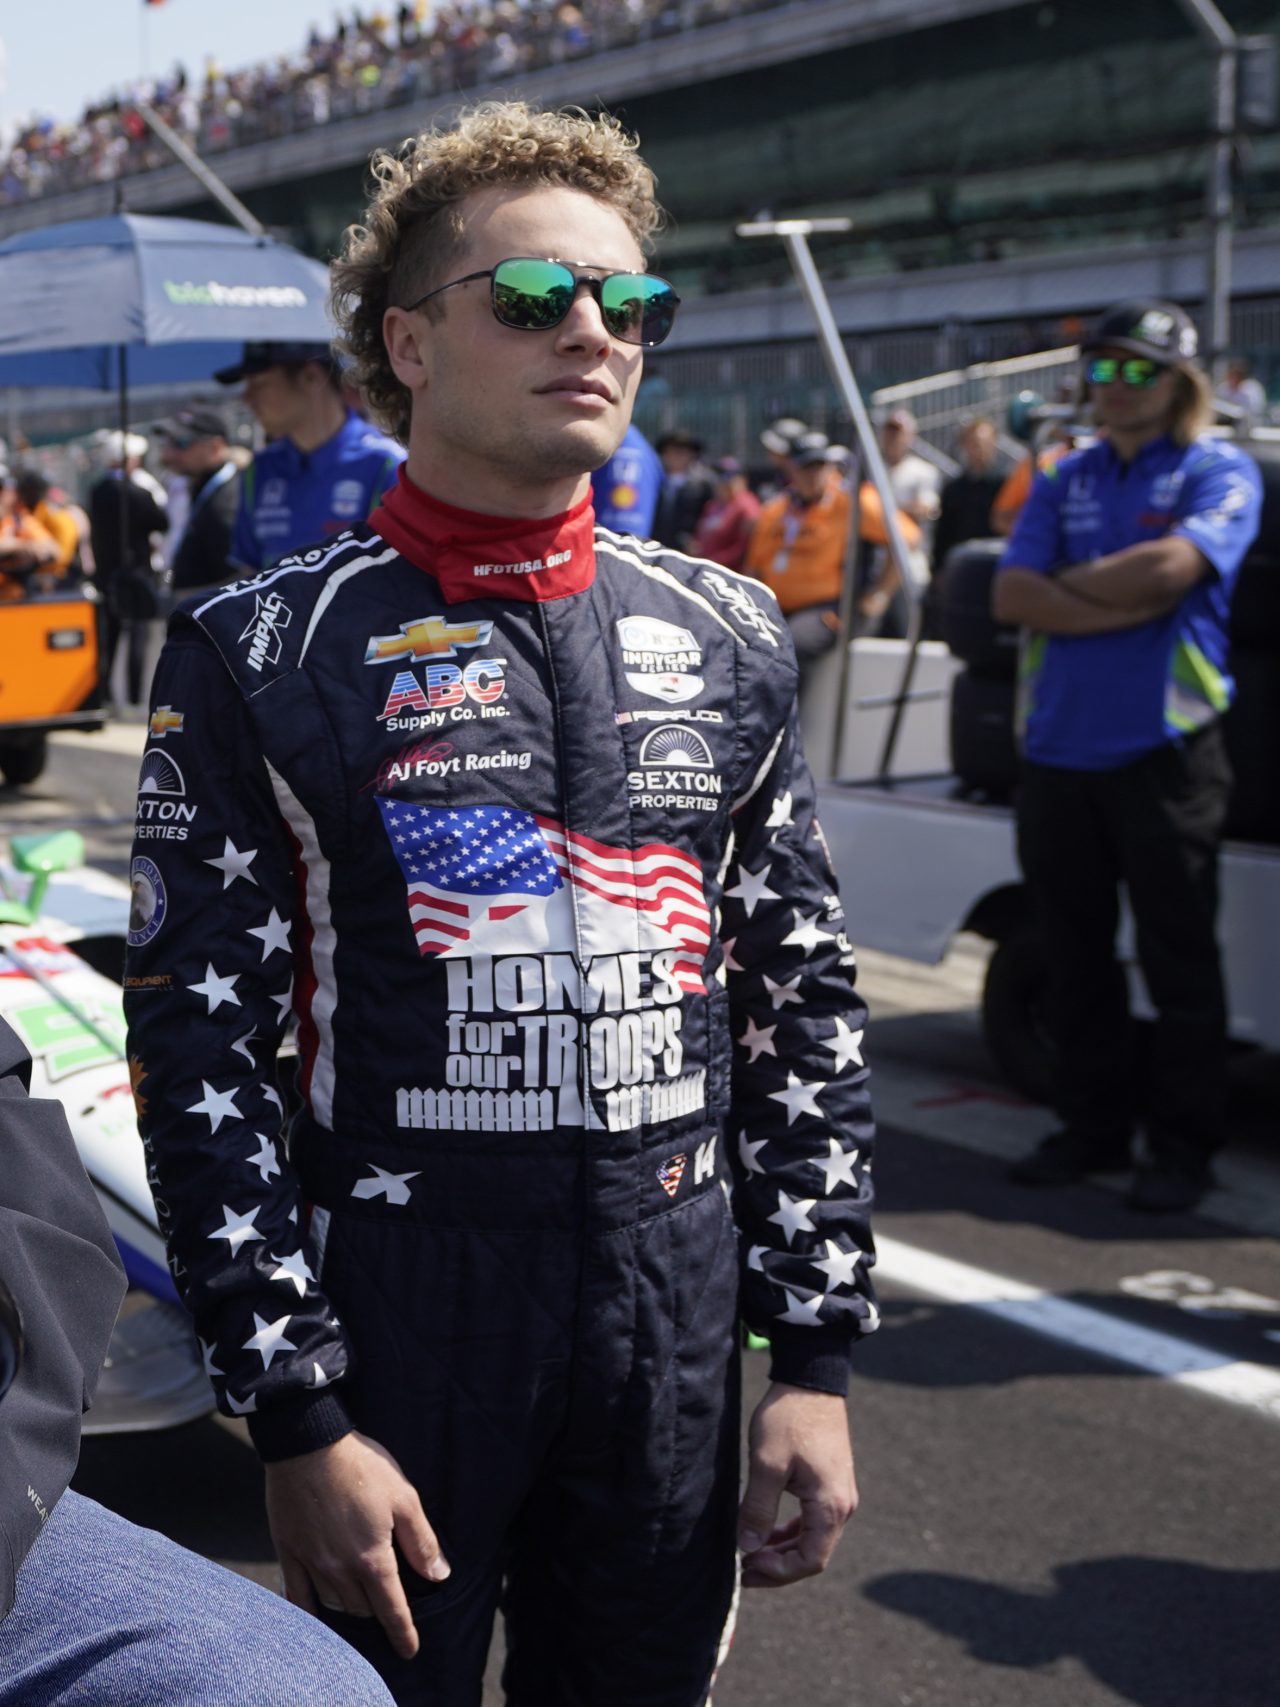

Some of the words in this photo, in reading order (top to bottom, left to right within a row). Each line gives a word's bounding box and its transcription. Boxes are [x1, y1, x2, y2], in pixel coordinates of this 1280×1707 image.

[473, 549, 572, 577] HFOTUSA.ORG
[247, 591, 285, 672] IMPACT
[622, 650, 702, 667] INDYCAR
[640, 662, 688, 673] SERIES
[376, 658, 508, 722] ABC
[386, 711, 446, 732] Supply
[450, 706, 477, 721] Co.
[480, 704, 511, 719] inc.
[387, 762, 411, 781] AJ
[415, 757, 461, 778] Foyt
[465, 750, 532, 771] Racing
[627, 771, 723, 794] SEXTON
[136, 800, 198, 822] XTON
[628, 793, 719, 812] PROPERTIES
[446, 950, 684, 1013] HOMES
[446, 1013, 517, 1055] for
[517, 1006, 683, 1129] TROOPS
[446, 1053, 522, 1088] our
[694, 1135, 718, 1185] 14
